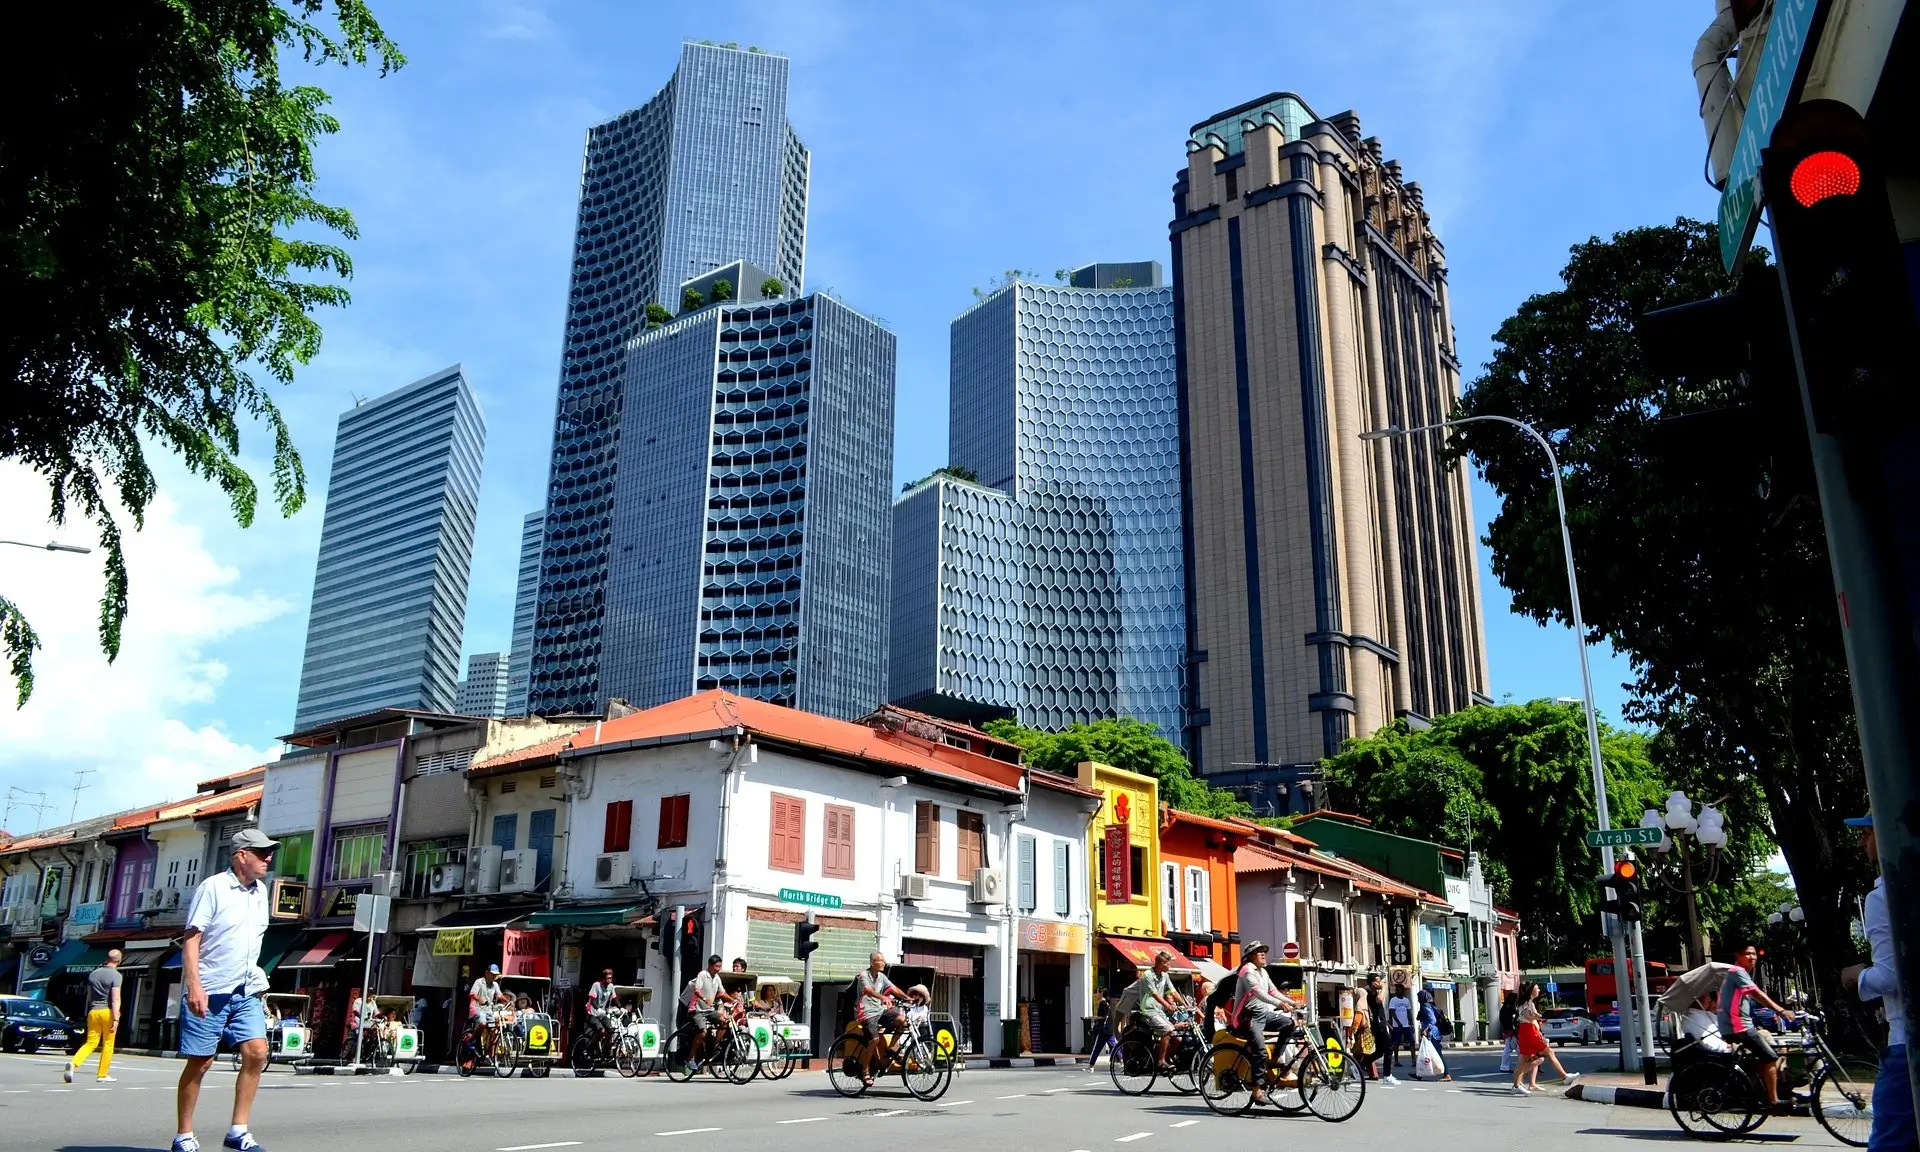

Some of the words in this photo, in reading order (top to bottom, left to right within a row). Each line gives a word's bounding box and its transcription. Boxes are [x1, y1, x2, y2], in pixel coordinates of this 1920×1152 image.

[1722, 125, 1759, 244] North
[1595, 831, 1632, 844] Arab
[1639, 830, 1655, 842] St
[280, 888, 302, 909] Angel
[783, 889, 804, 901] North
[805, 892, 829, 905] Bridge
[830, 896, 839, 906] Rd
[1027, 923, 1048, 944] GB
[1392, 907, 1406, 963] TATTOO
